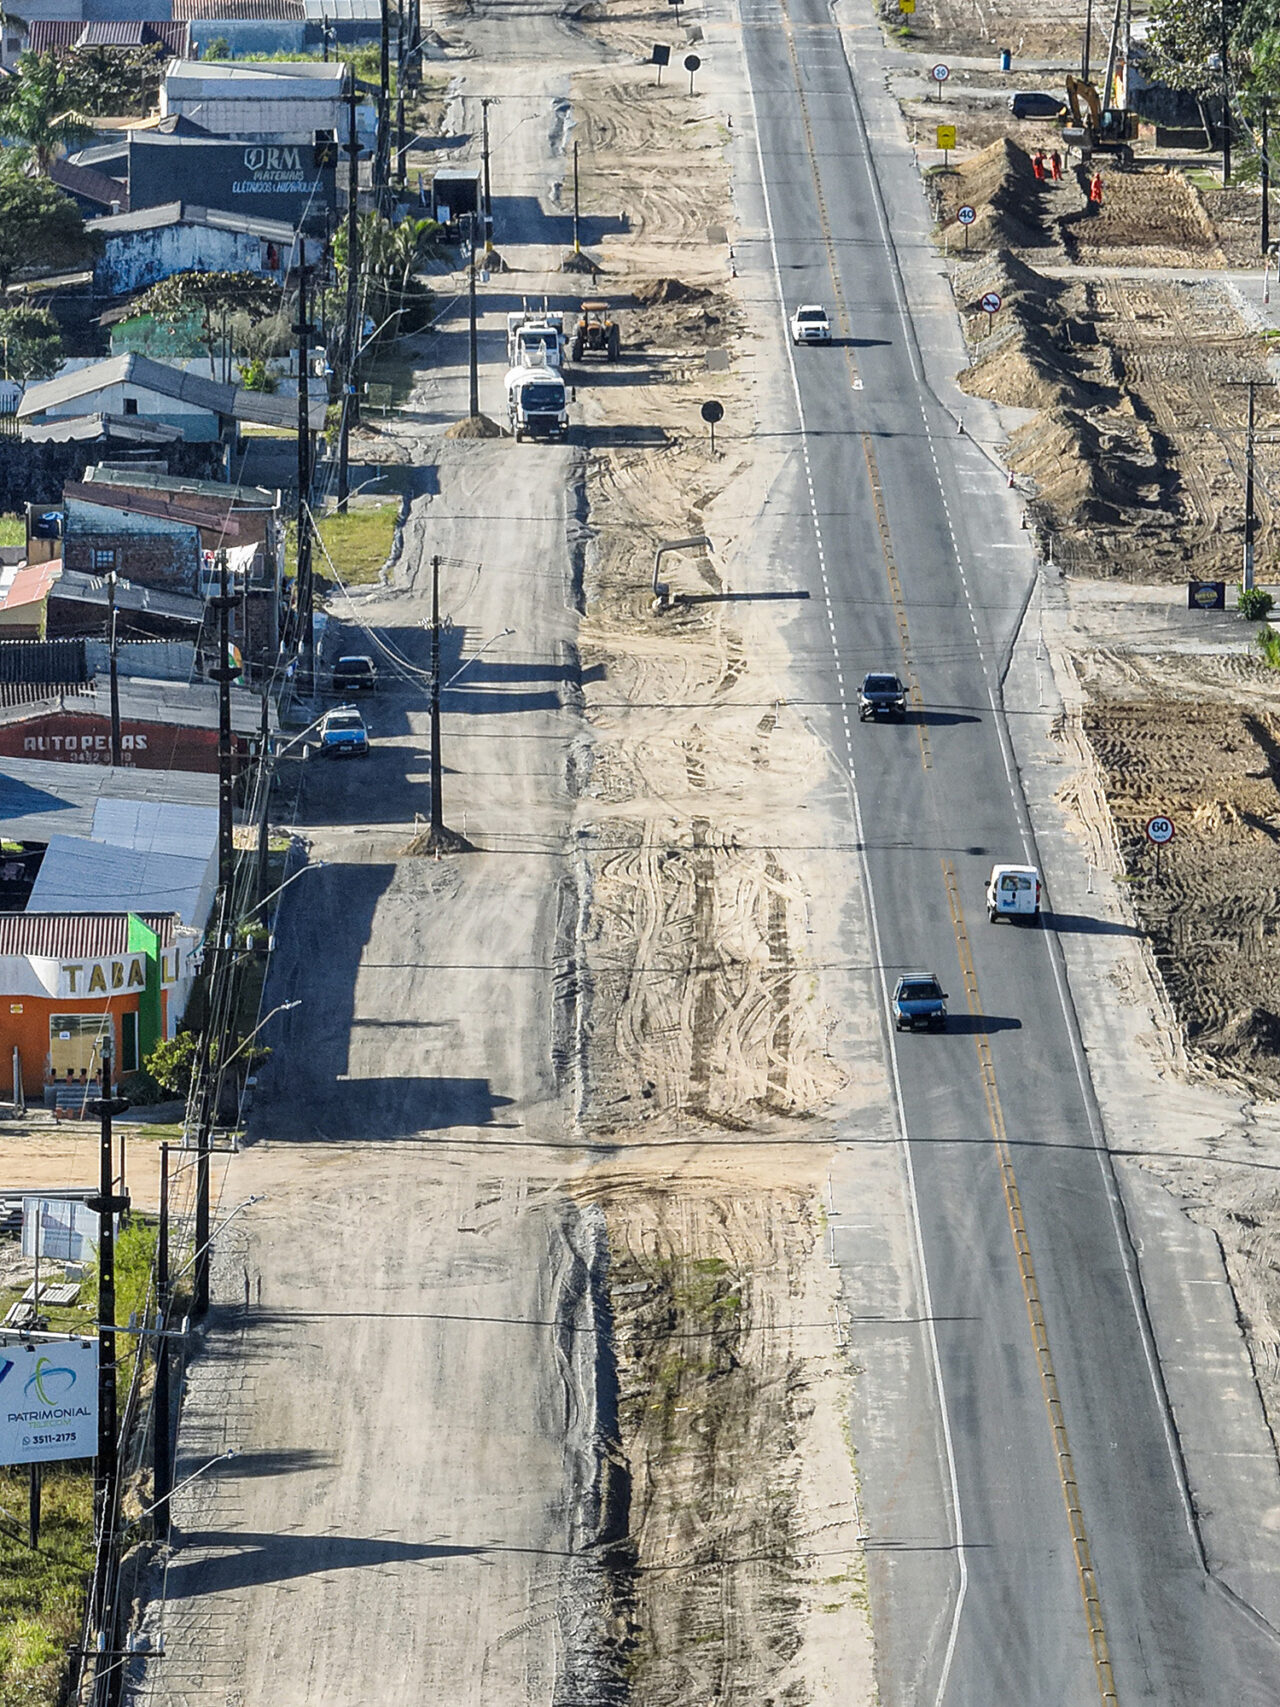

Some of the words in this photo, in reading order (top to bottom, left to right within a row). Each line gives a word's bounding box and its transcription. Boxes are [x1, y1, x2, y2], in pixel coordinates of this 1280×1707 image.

[266, 147, 302, 170] RM
[959, 210, 974, 219] 40
[81, 735, 148, 750] PEAS
[1152, 821, 1169, 833] 60
[7, 1406, 91, 1422] PATRIMONIAL
[33, 1432, 77, 1445] 3511-2175
